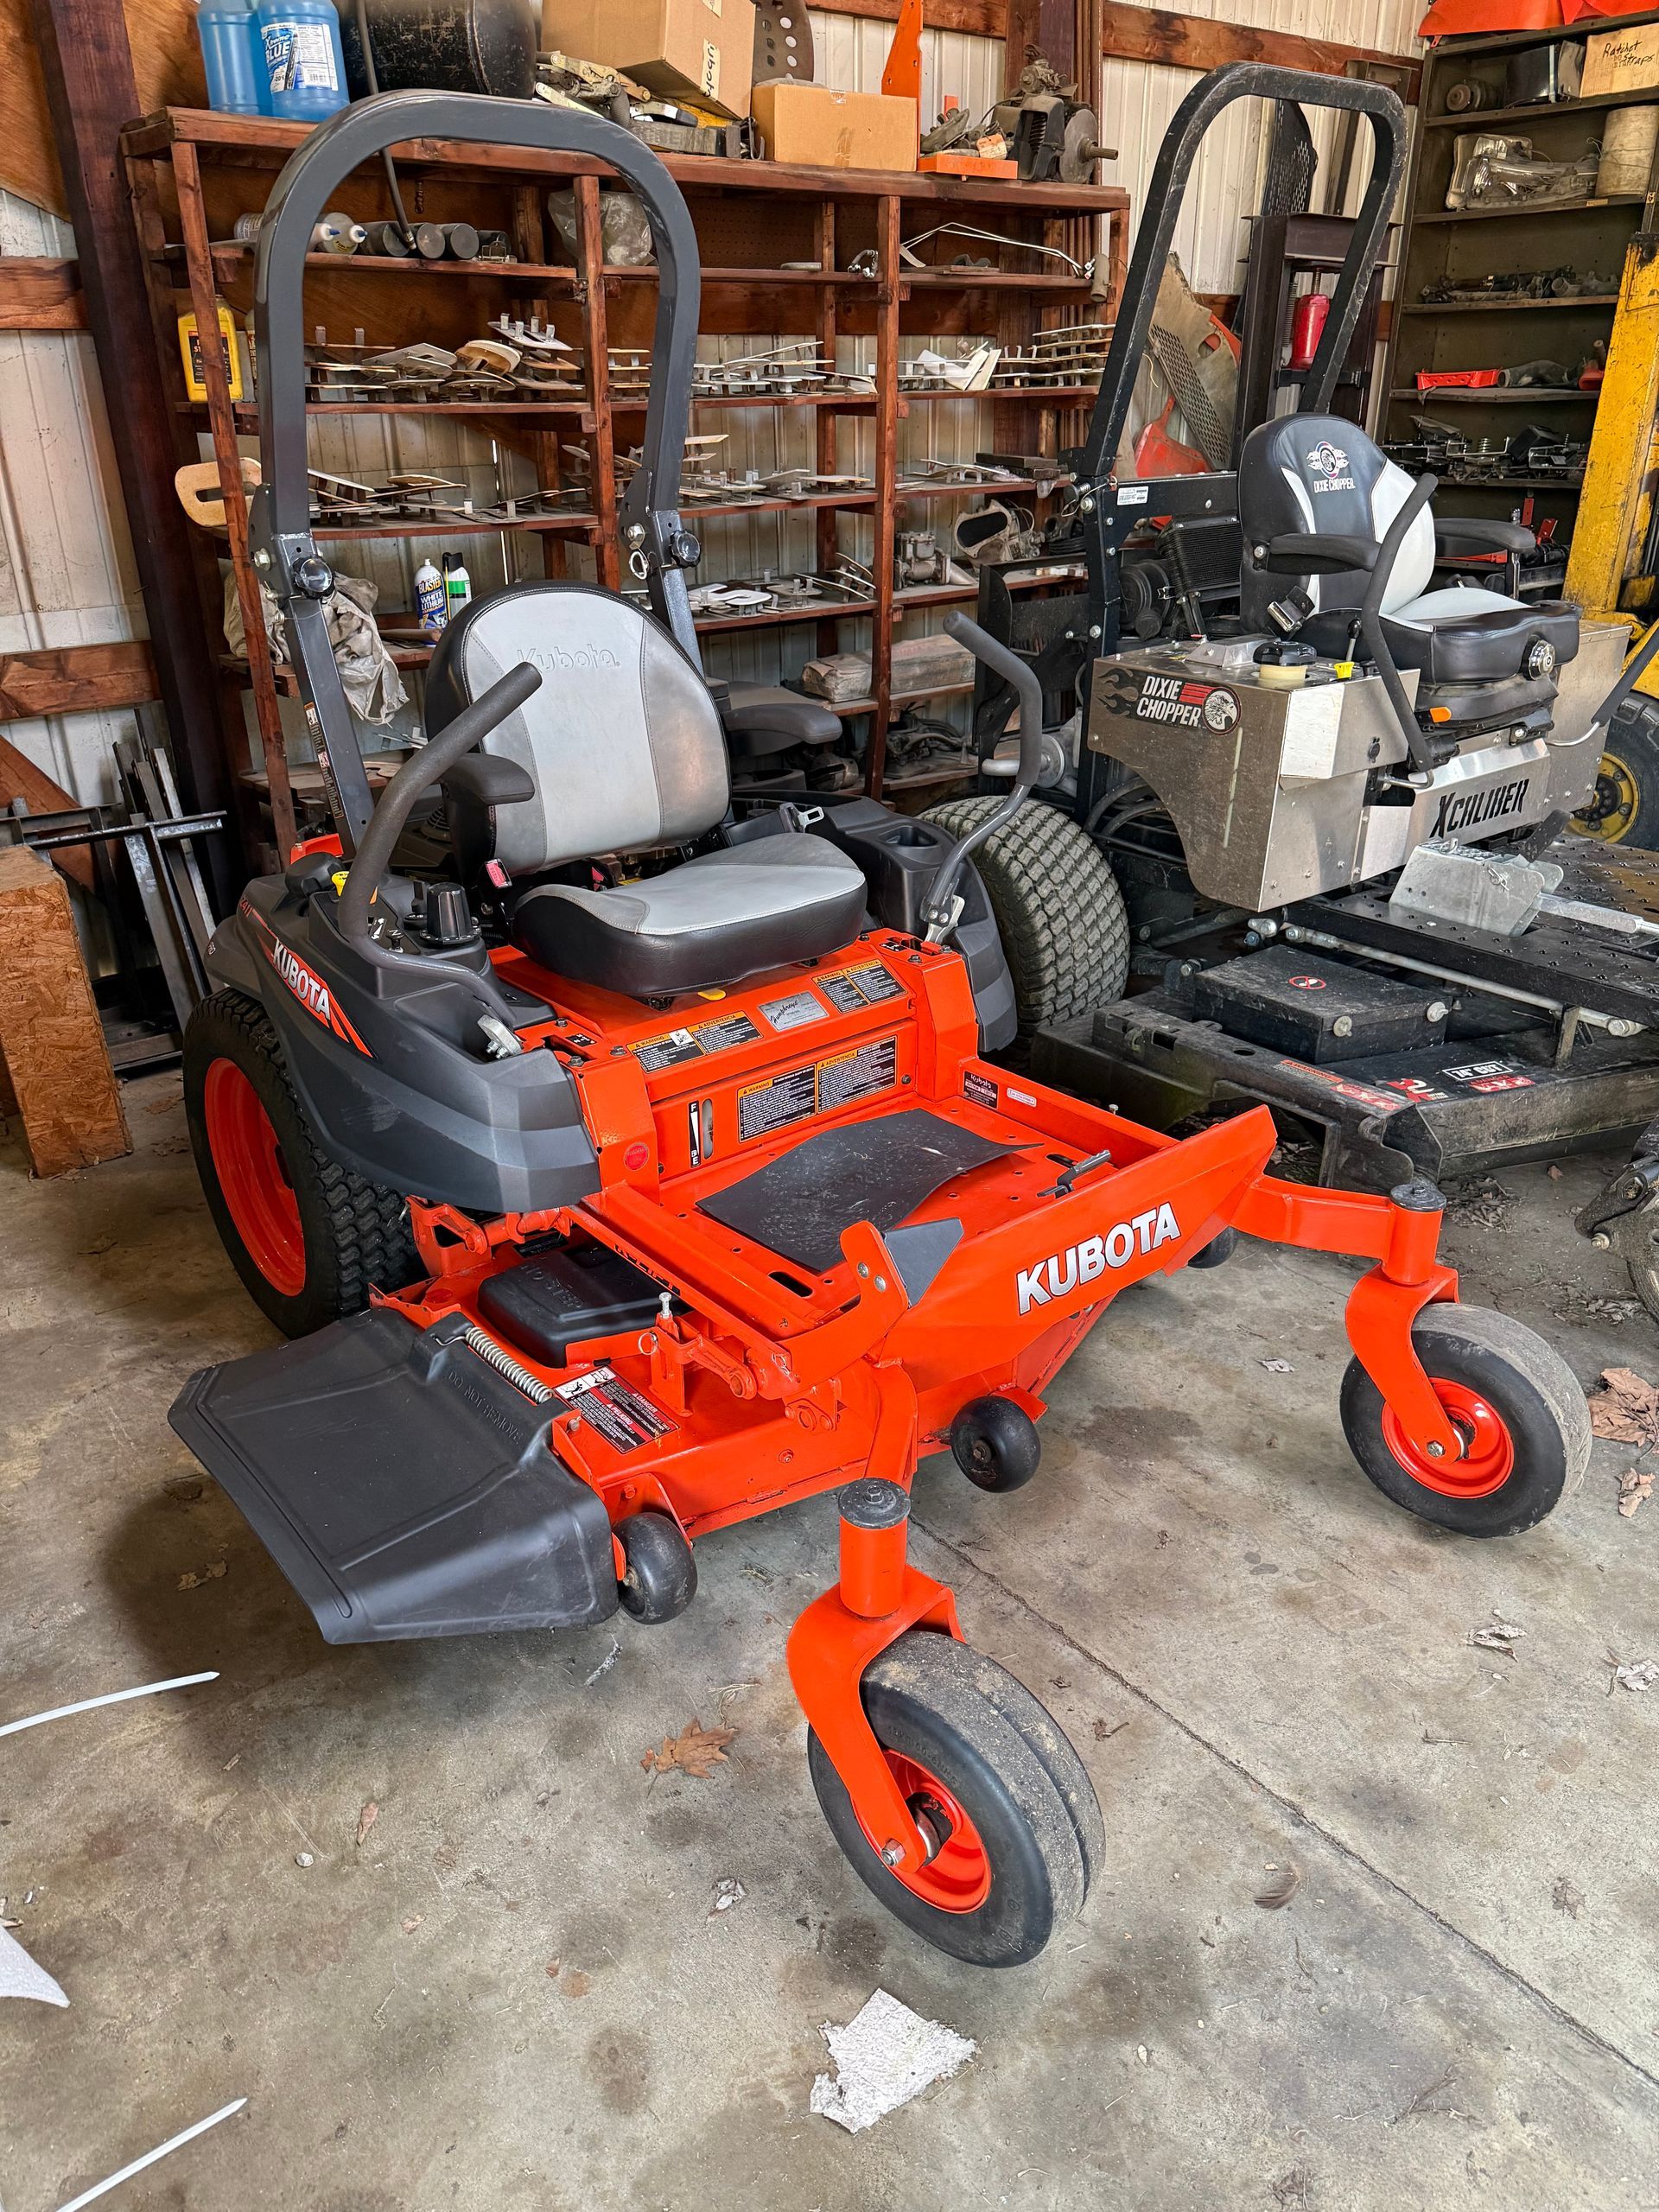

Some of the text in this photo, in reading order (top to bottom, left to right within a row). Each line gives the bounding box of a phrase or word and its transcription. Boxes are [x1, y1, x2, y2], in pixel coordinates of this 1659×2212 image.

[1602, 39, 1643, 58] Ratchet
[1621, 53, 1656, 67] Straps
[1313, 477, 1356, 493] DIXIE CHOPPER
[421, 589, 443, 604] WHITE
[421, 596, 444, 611] LITHIUM
[1141, 676, 1183, 702] DIXIE
[1136, 696, 1203, 728] CHOPPER
[1428, 778, 1530, 840] XCALIBER
[271, 937, 332, 1021] KUBOTA
[703, 1014, 736, 1027] ADVERTENCIA
[641, 1035, 665, 1047] WARNING
[825, 1052, 855, 1066] ADVERTENCIA
[1472, 1064, 1503, 1075] CUT
[748, 1081, 770, 1094] WARNING
[970, 1074, 992, 1090] Kubota
[690, 1103, 697, 1112] F
[692, 1156, 699, 1166] E
[1016, 1201, 1182, 1316] KUBOTA
[448, 1370, 524, 1446] DO NOT REMOVE
[635, 1393, 658, 1414] DANGER
[610, 1406, 633, 1426] PELIGRO
